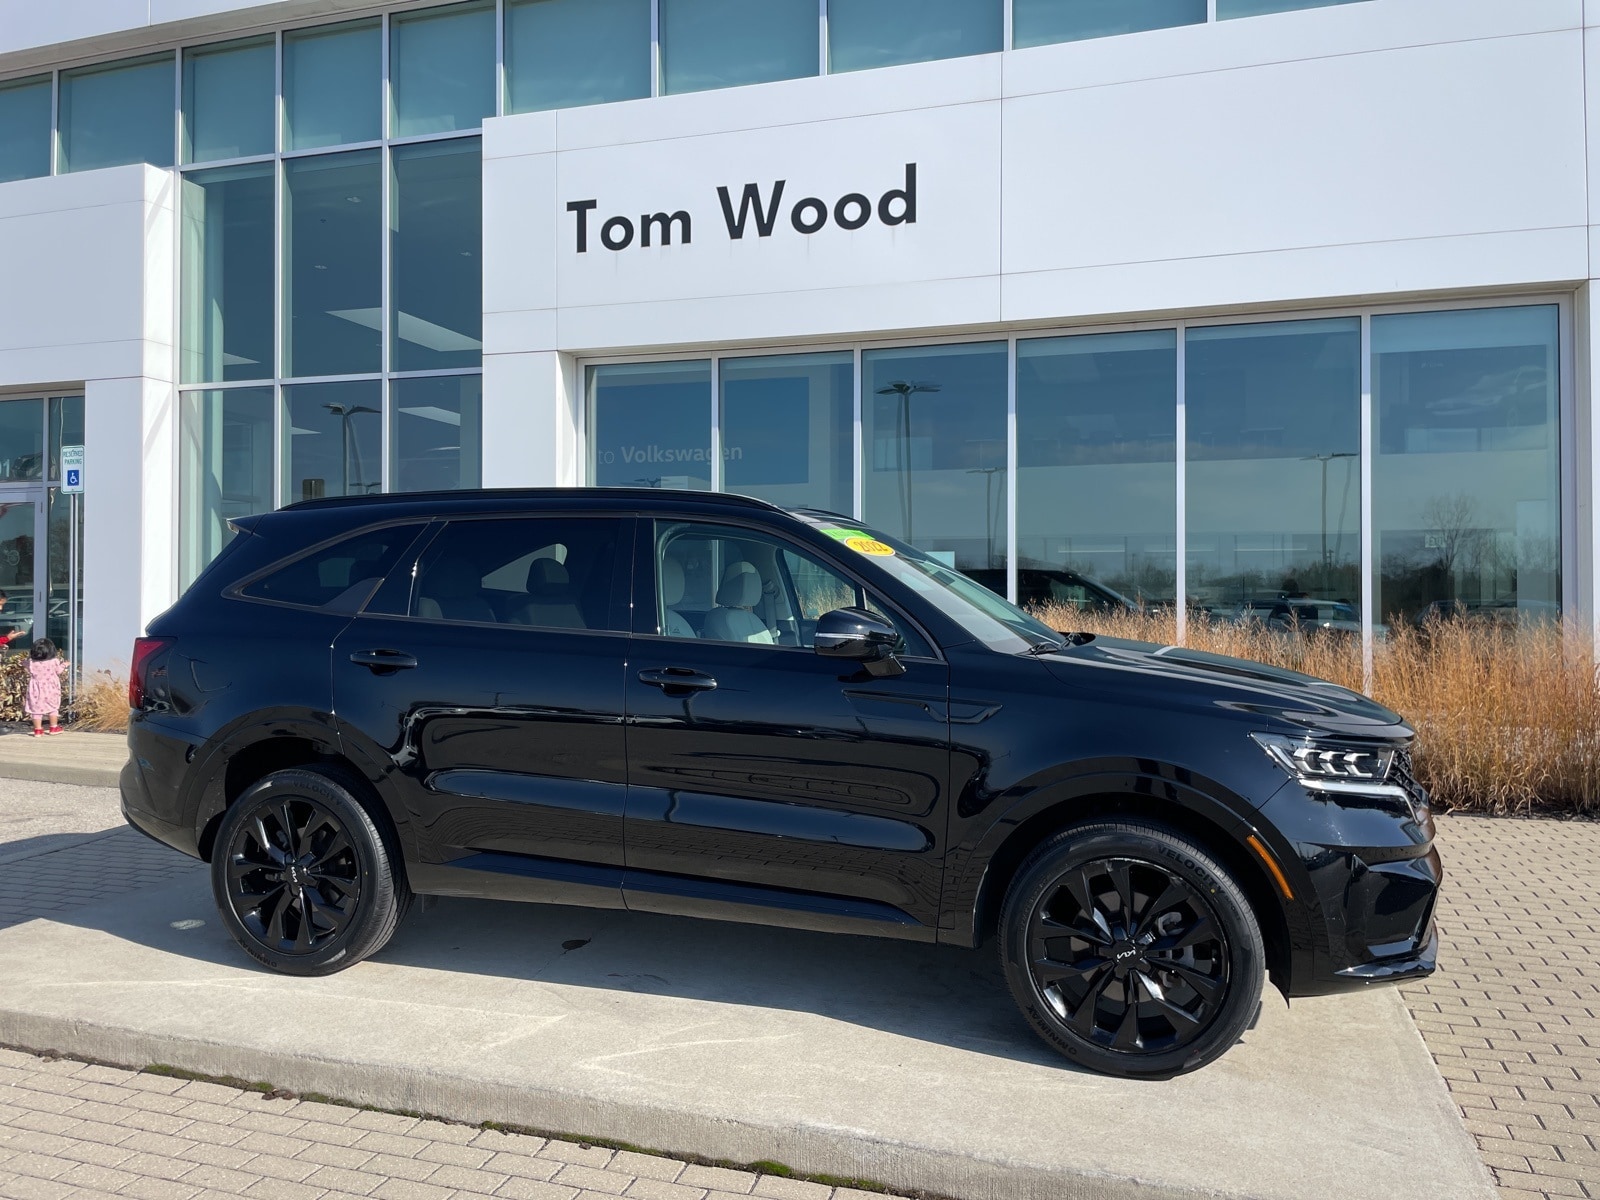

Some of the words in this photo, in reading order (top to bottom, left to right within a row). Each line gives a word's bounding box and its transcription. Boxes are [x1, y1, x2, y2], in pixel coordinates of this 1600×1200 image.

[566, 198, 692, 254] Tom
[716, 162, 917, 240] Wood
[62, 449, 83, 457] RESERVED
[598, 449, 615, 465] to
[0, 458, 10, 478] 1
[1157, 843, 1226, 896] VELOCITY
